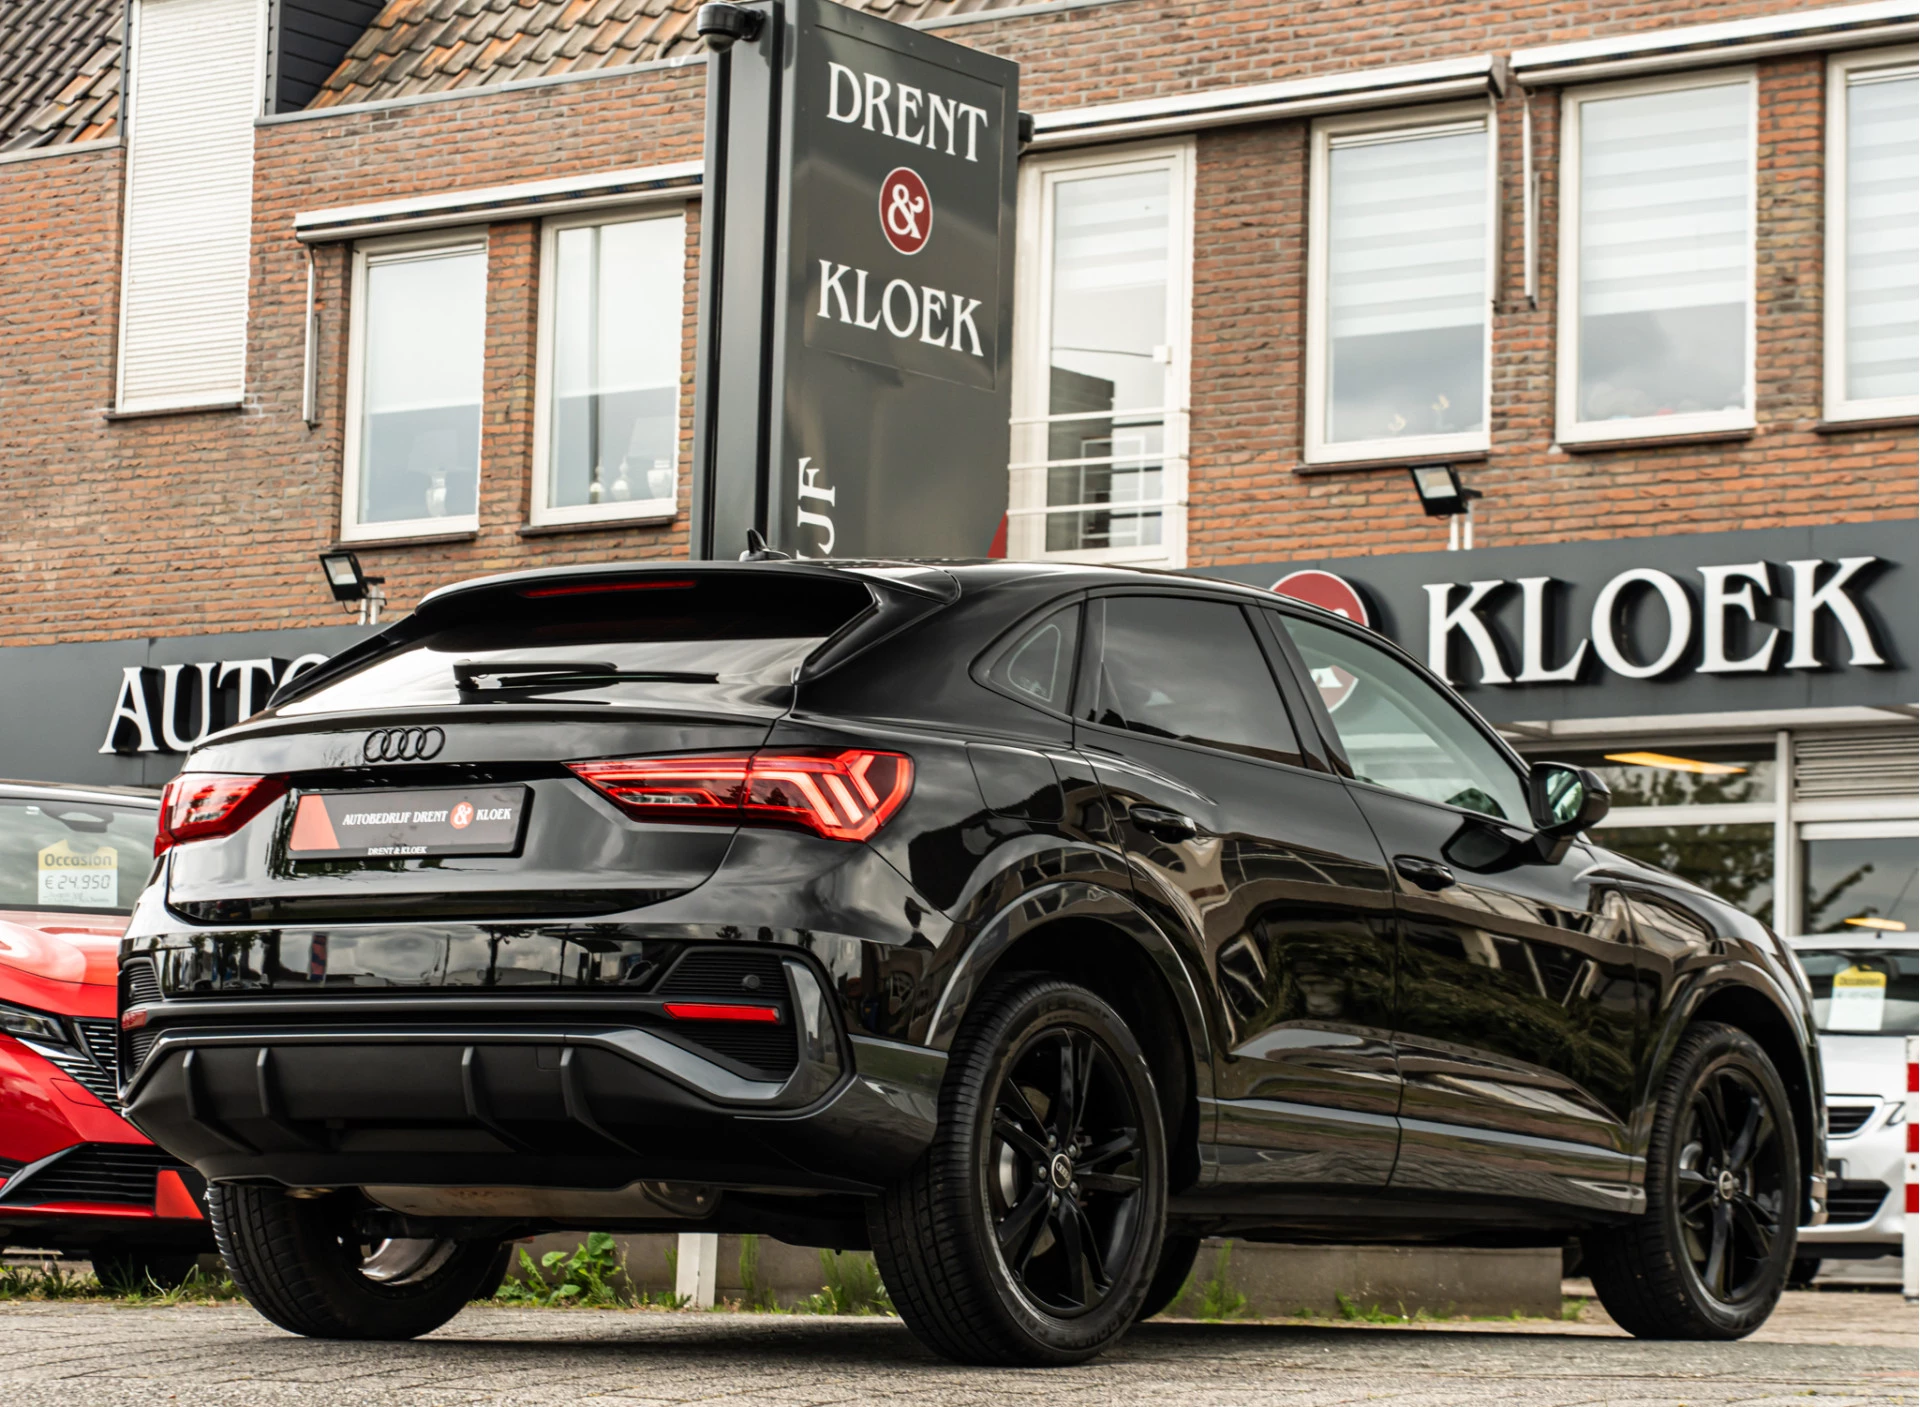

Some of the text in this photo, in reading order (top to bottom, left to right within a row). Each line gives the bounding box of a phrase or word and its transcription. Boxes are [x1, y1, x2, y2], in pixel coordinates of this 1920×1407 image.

[827, 61, 988, 162] DRENT
[887, 183, 925, 239] &
[817, 259, 984, 357] KLOEK
[796, 456, 836, 560] JF
[1422, 556, 1885, 686] KLOEK
[342, 804, 512, 825] AUTOBEDRIJF DRENT & KLOEK
[44, 854, 112, 867] Occasion
[367, 847, 393, 855] DRENT
[400, 846, 427, 855] KLOEK
[45, 875, 54, 890] €
